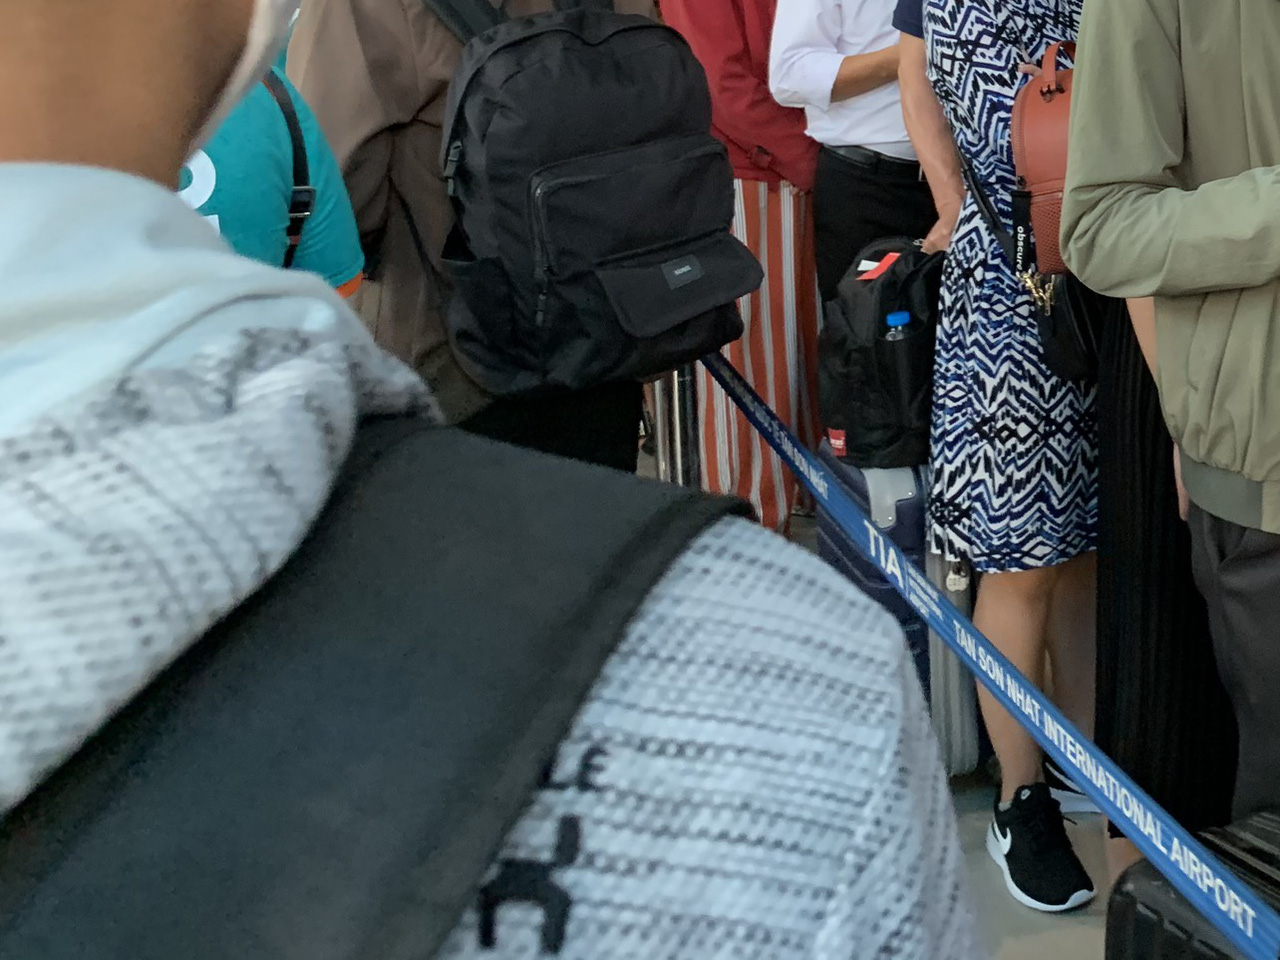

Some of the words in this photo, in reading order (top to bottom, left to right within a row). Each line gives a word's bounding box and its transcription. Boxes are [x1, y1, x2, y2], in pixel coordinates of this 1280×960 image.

[953, 619, 977, 662] TAN
[978, 646, 1005, 691] SON
[1006, 673, 1041, 727] NHAT
[1043, 710, 1168, 855] INTERNATIONAL
[1170, 837, 1257, 938] AIRPORT
